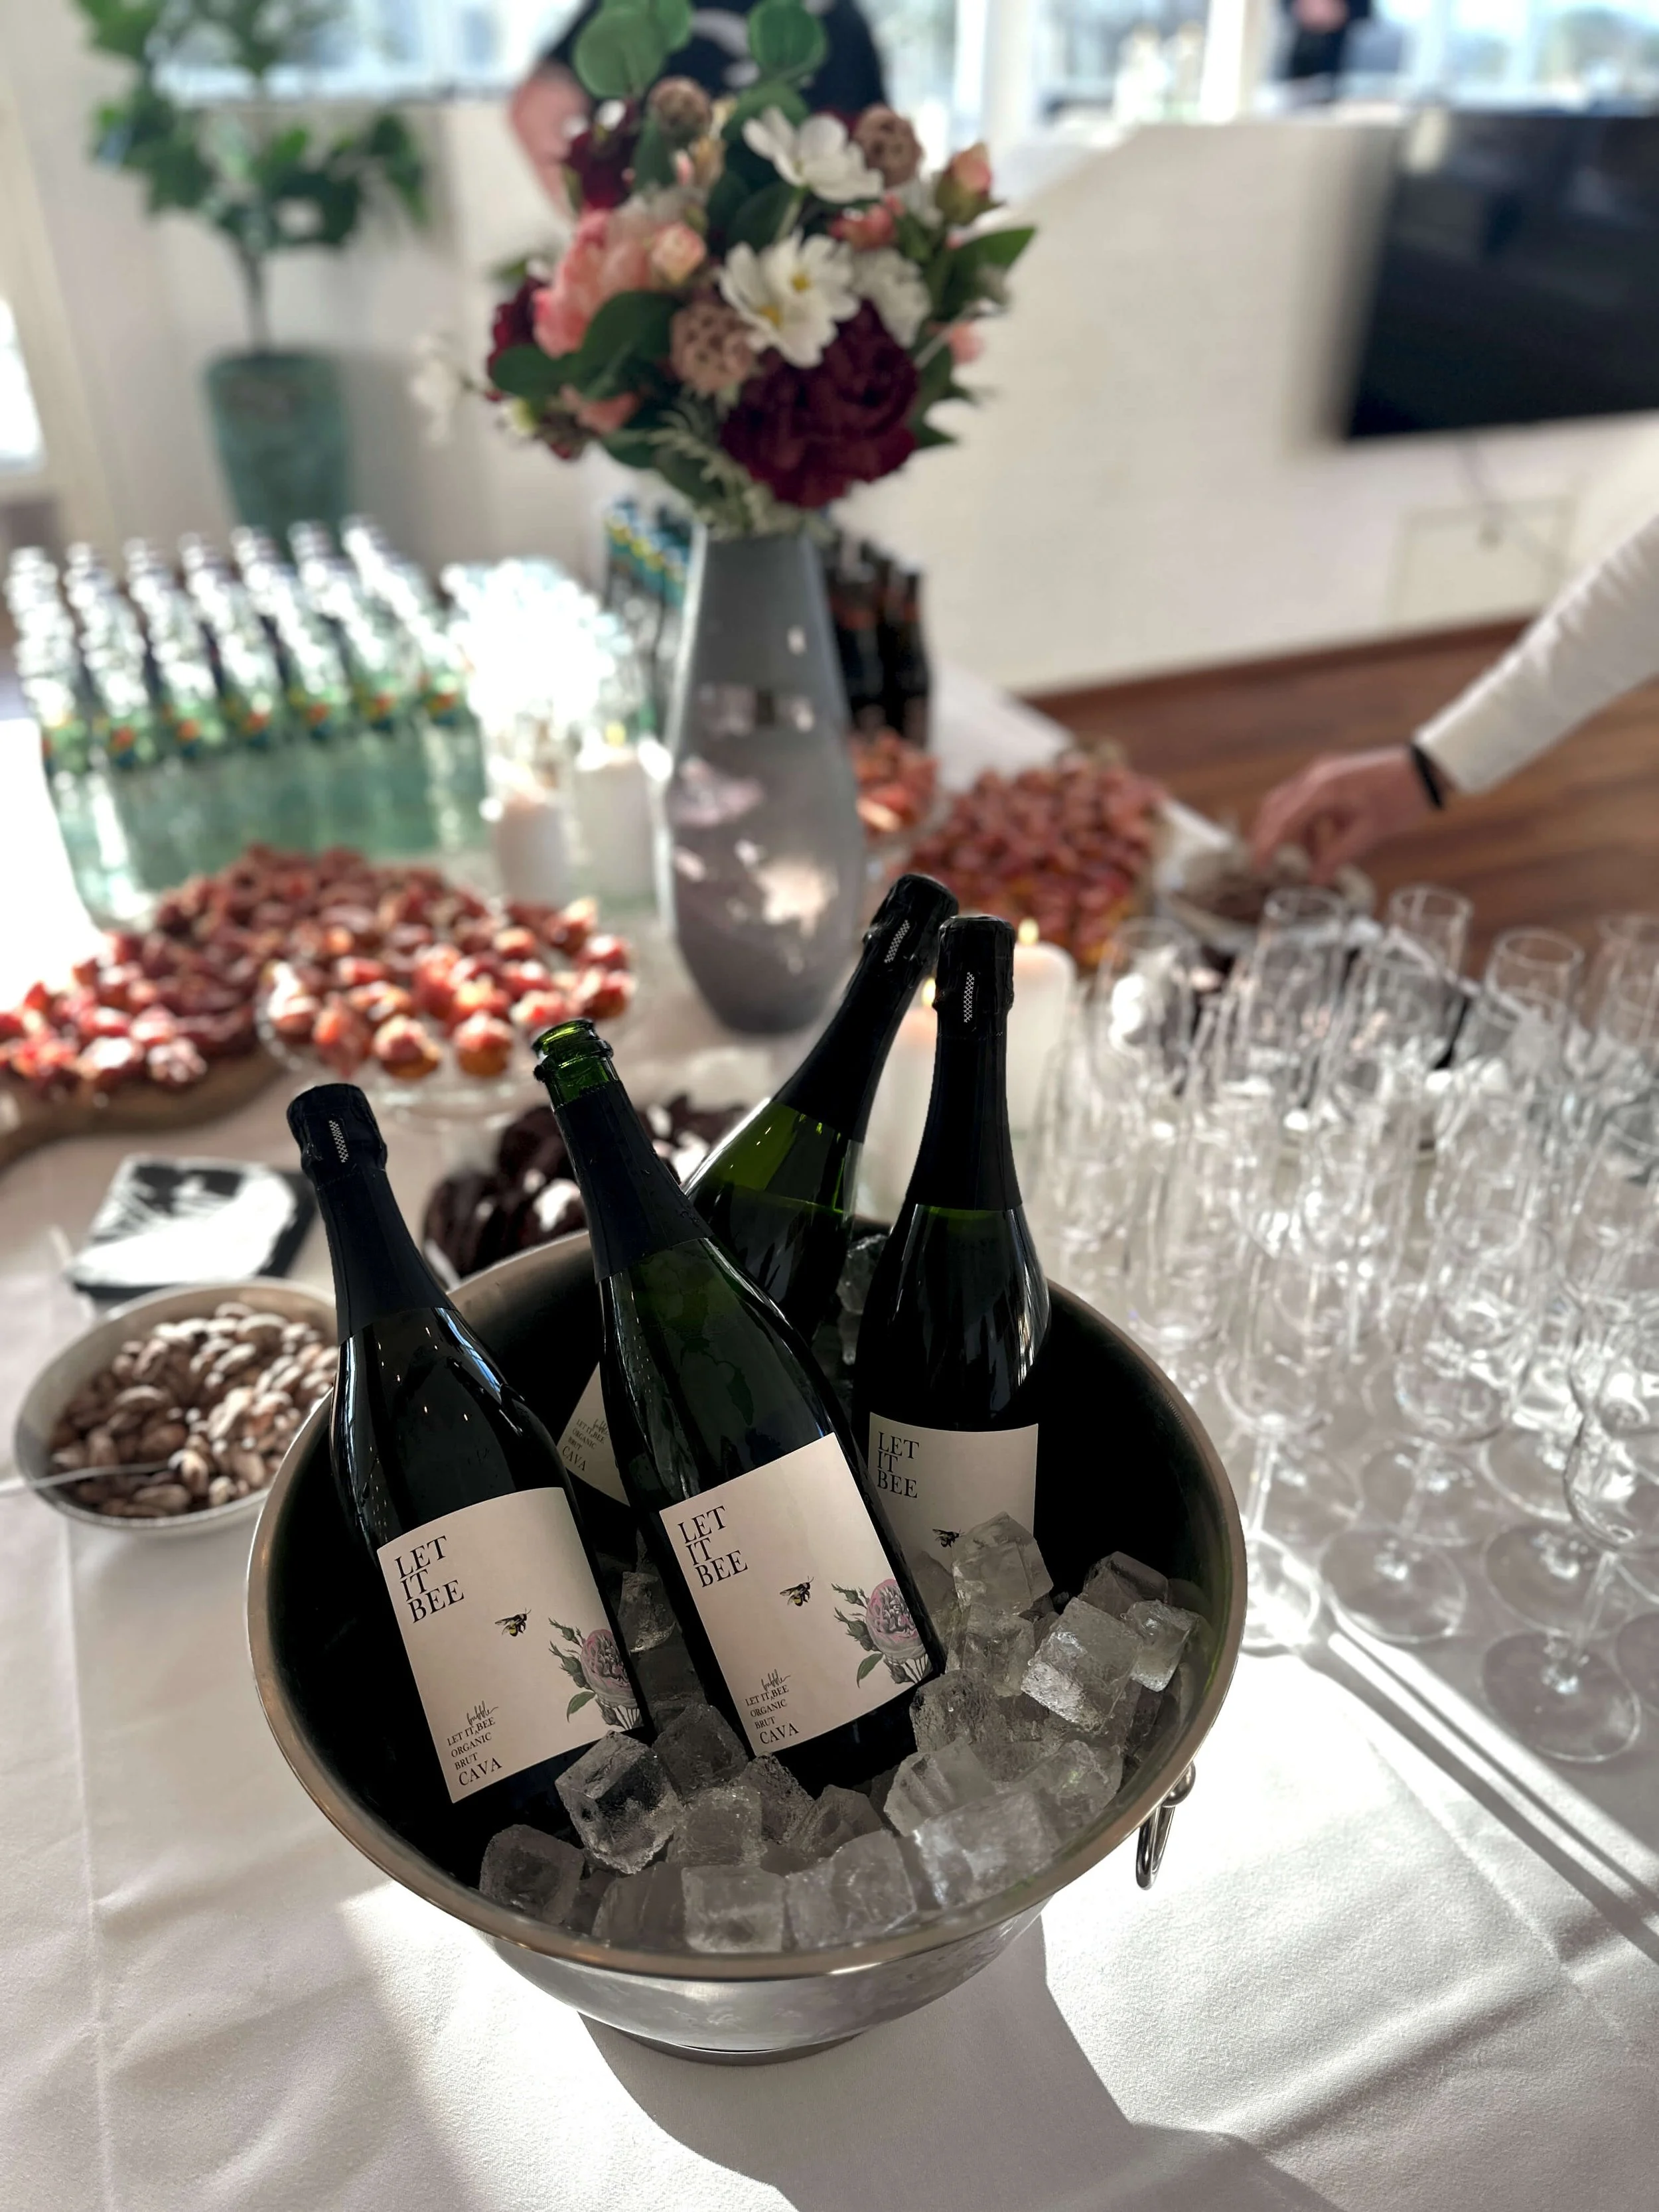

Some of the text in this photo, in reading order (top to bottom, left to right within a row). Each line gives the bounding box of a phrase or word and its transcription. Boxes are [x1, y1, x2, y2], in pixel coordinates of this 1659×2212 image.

[577, 1419, 587, 1430] LET
[568, 1436, 582, 1450] BRUT
[573, 1428, 597, 1449] ORGANIC
[878, 1432, 920, 1459] LET
[563, 1445, 585, 1471] CAVA
[877, 1451, 898, 1473] IT
[877, 1469, 918, 1499] BEE
[678, 1505, 726, 1544] LET
[395, 1535, 447, 1579] LET
[685, 1537, 712, 1566] IT
[694, 1550, 748, 1587] BEE
[400, 1569, 428, 1601] IT
[407, 1580, 465, 1623] BEE
[745, 1684, 789, 1706] LET IT BEE
[750, 1698, 787, 1718] ORGANIC
[447, 1717, 496, 1746] LET IT BEE
[755, 1716, 775, 1730] BRUT
[760, 1723, 799, 1744] CAVA
[451, 1732, 492, 1757] ORGANIC
[455, 1752, 478, 1770] BRUT
[459, 1757, 502, 1785] CAVA
